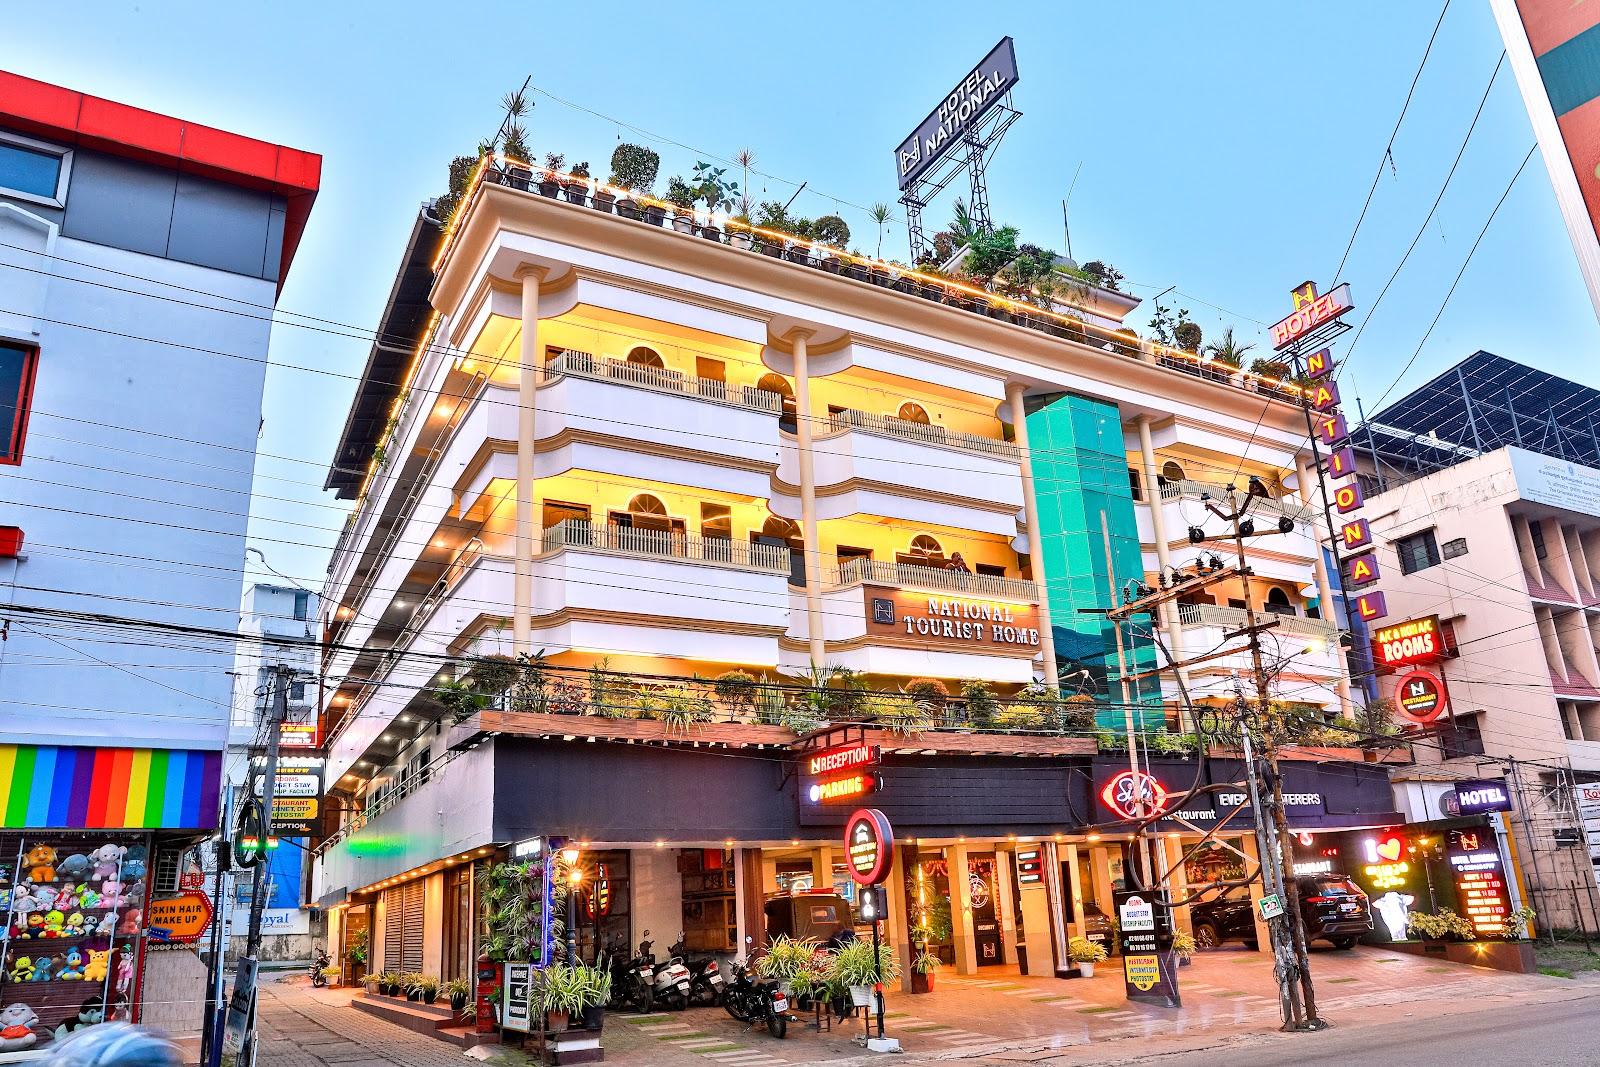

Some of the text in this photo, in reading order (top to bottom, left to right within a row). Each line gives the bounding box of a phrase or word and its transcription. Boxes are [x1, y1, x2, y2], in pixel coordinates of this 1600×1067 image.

[938, 70, 986, 122] HOTEL
[925, 70, 1006, 156] NATIONAL
[1274, 294, 1342, 344] HOTEL
[1308, 352, 1376, 618] NATIONAL
[928, 597, 1014, 623] NATIONAL
[903, 615, 1040, 646] TOURIST HOME
[1383, 633, 1434, 662] ROOMS
[1402, 694, 1437, 706] RESTAURANT
[821, 745, 869, 771] RECEPTION
[820, 776, 863, 799] PARKING
[1459, 787, 1507, 806] HOTEL
[152, 905, 202, 914] SKIN HAIR
[185, 915, 197, 923] UP
